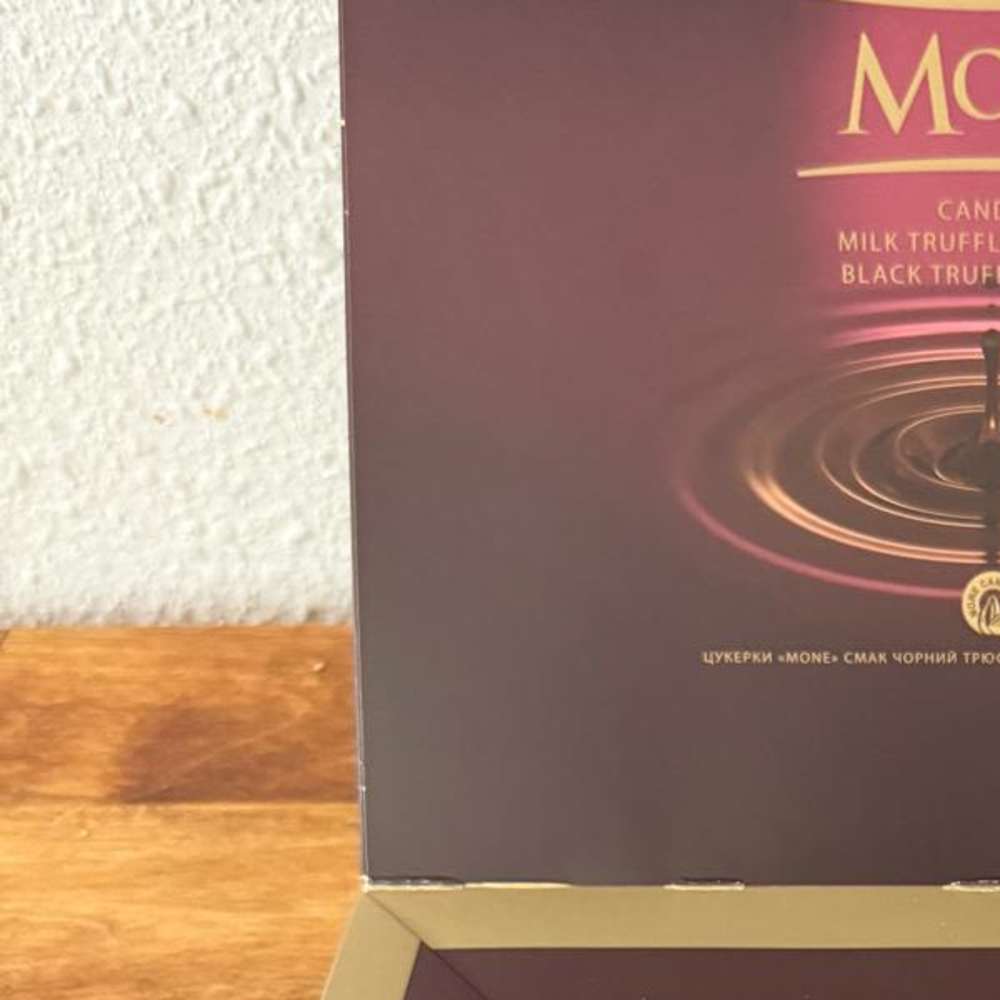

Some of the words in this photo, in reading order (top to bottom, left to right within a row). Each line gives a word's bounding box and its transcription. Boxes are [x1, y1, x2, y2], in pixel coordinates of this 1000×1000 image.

[838, 231, 900, 254] MILK
[841, 263, 923, 286] BLACK
[702, 652, 773, 666] ЦУКЕРКИ
[843, 651, 887, 664] СМАК
[891, 649, 958, 664] ЧОРНИЙ
